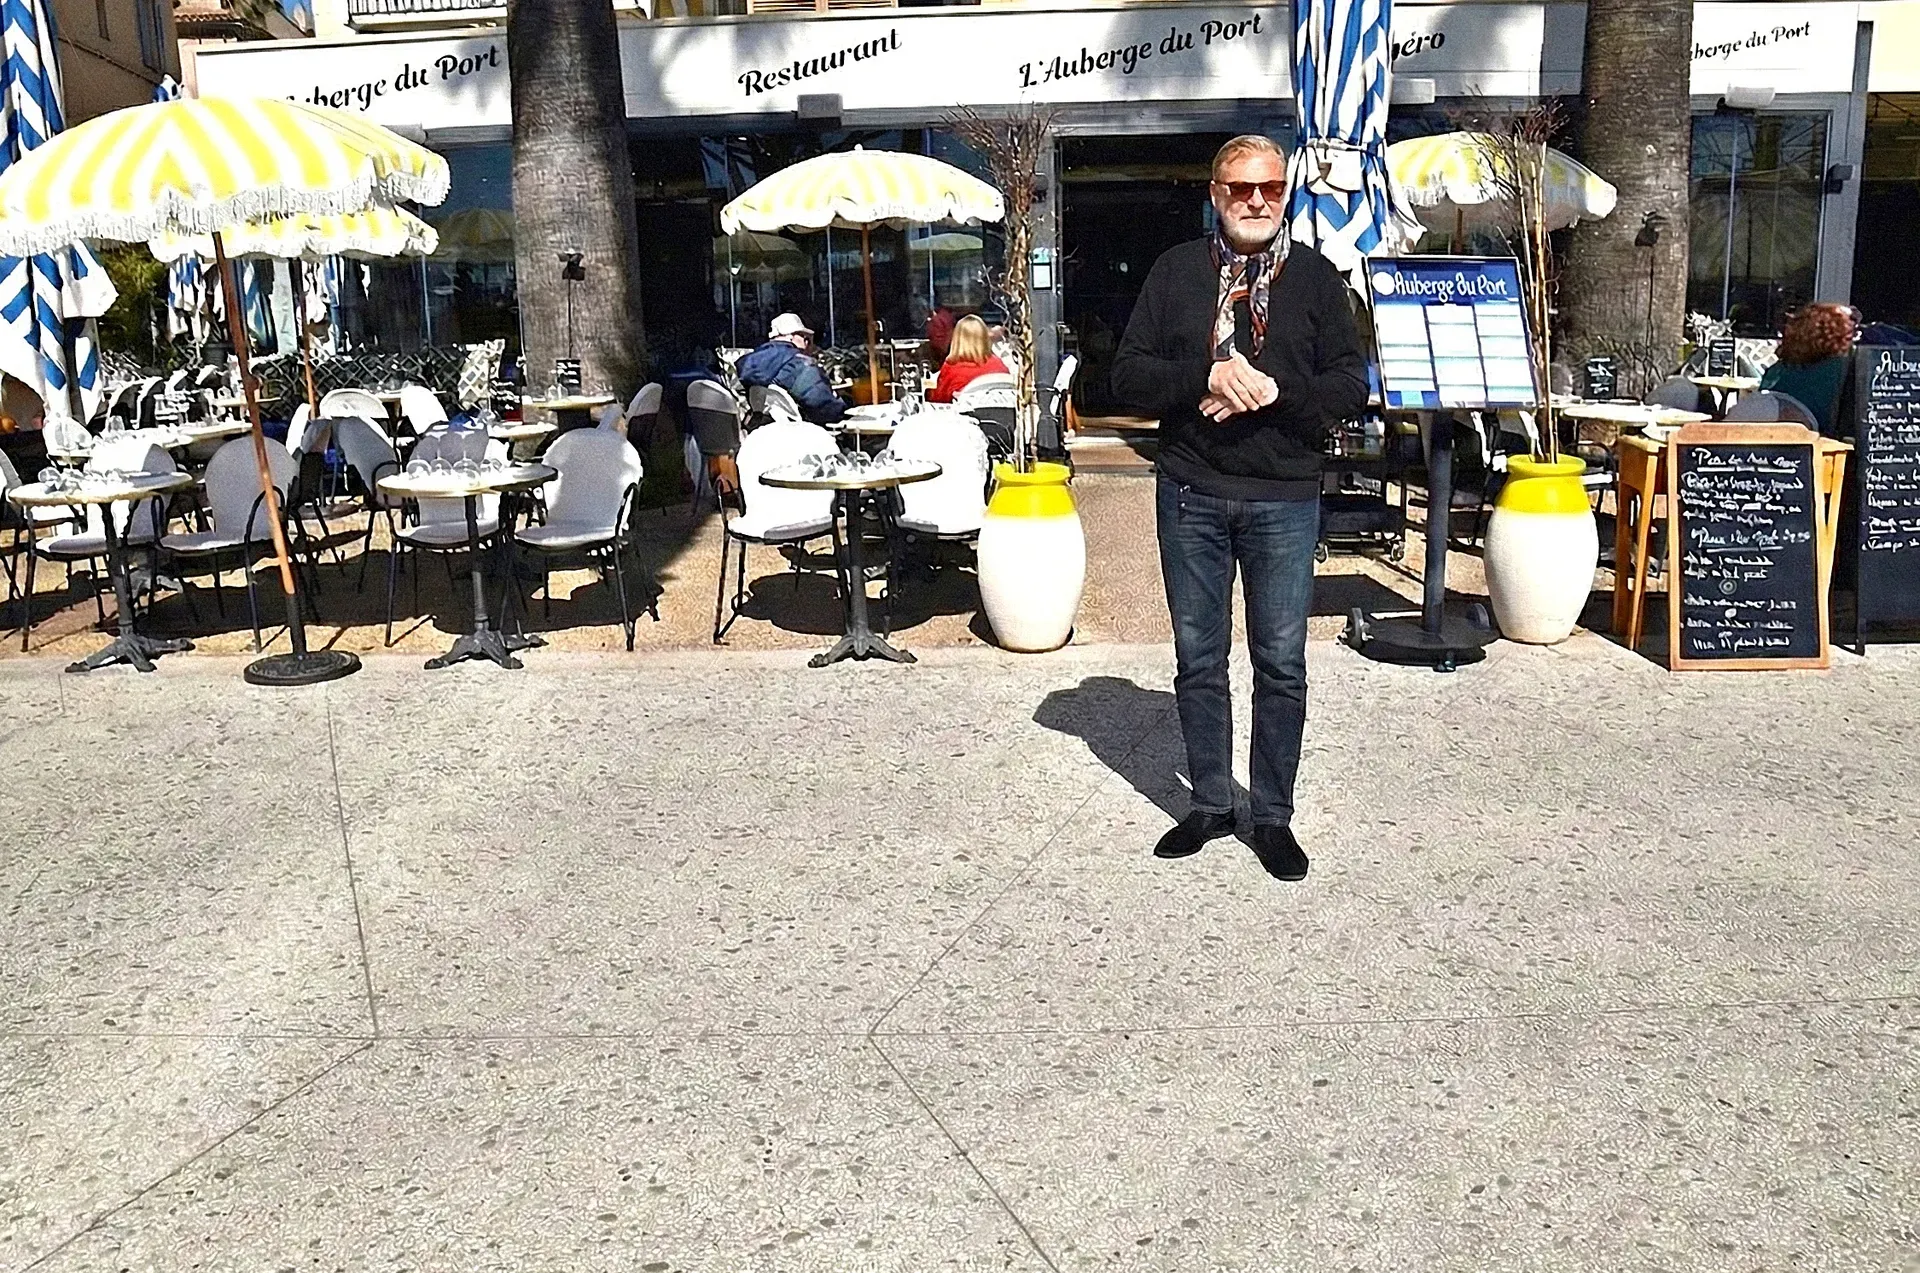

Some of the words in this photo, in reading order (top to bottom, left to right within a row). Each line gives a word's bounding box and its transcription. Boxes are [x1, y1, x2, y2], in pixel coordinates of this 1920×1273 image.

[737, 28, 903, 96] Restaurant
[1018, 41, 1152, 88] L'Auberge
[1159, 26, 1195, 55] du
[1200, 13, 1264, 45] Port
[1689, 39, 1742, 61] berge
[1745, 31, 1767, 48] du
[1771, 21, 1811, 42] Port
[394, 63, 430, 92] du
[434, 45, 500, 80] Port
[1394, 271, 1455, 303] Auberge
[1456, 271, 1478, 296] du
[1477, 274, 1508, 295] Port
